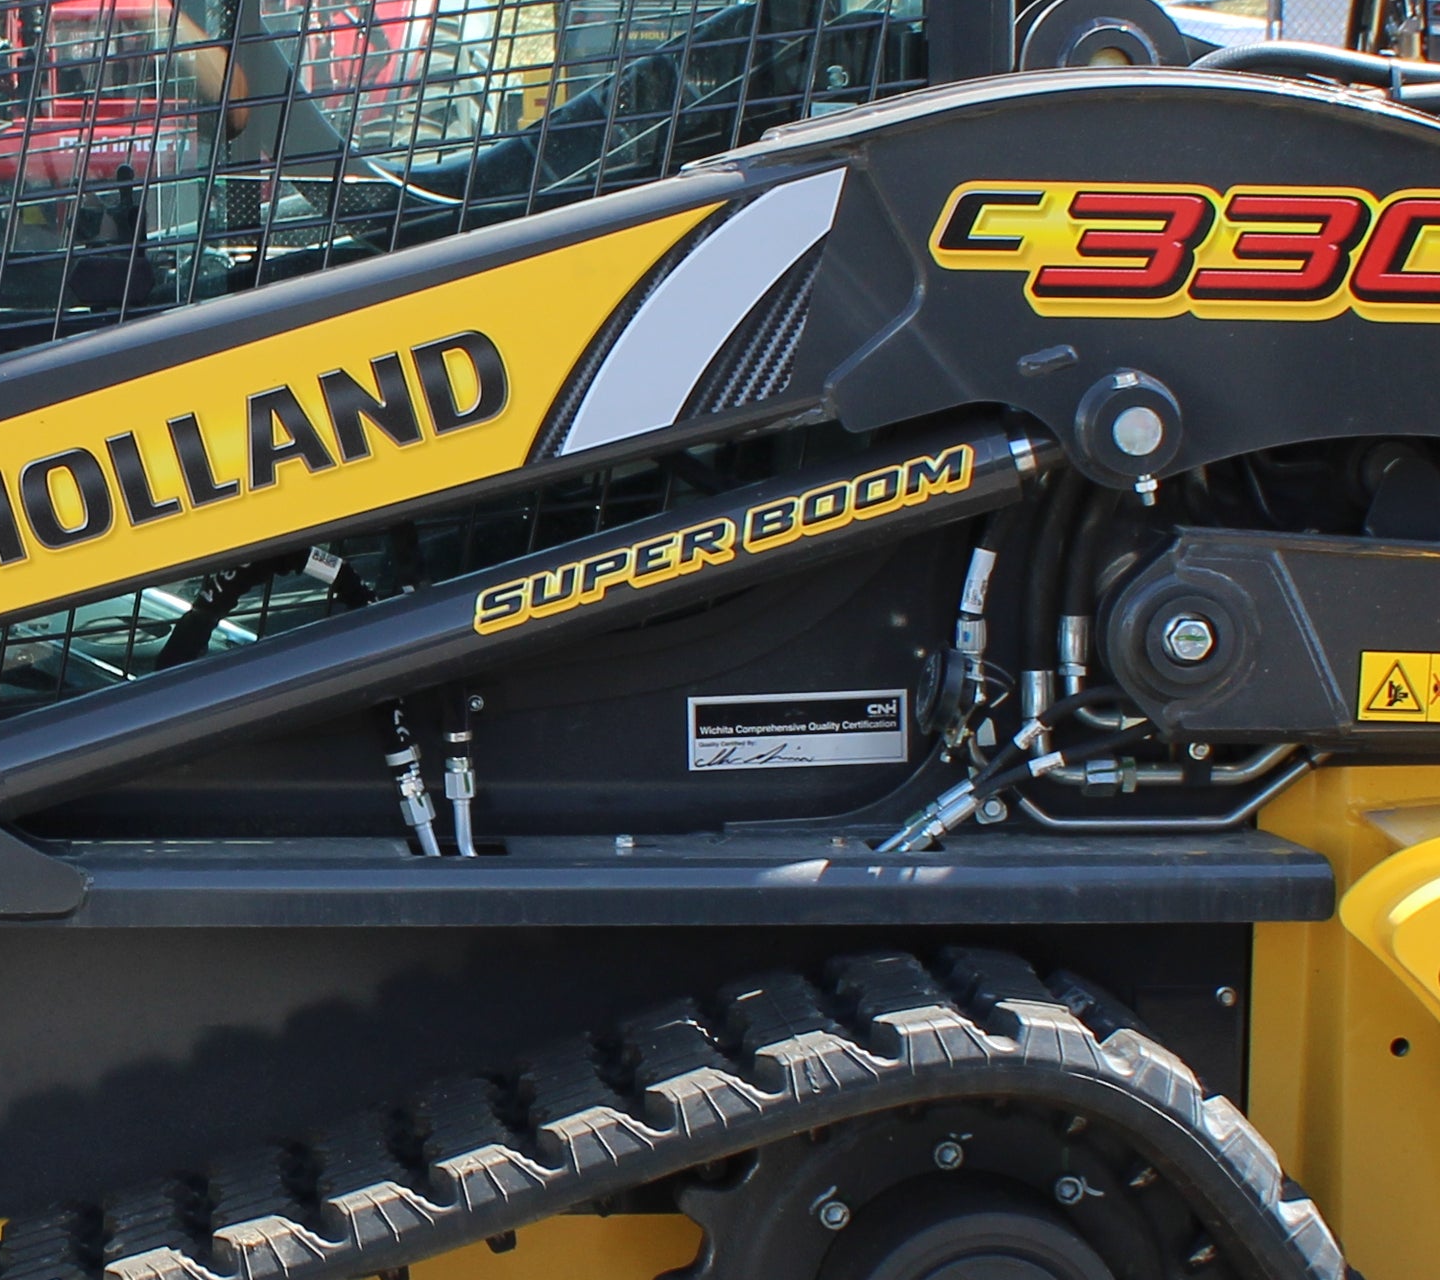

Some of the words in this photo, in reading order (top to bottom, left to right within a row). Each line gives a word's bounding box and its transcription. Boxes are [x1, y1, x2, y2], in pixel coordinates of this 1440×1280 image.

[474, 518, 735, 636] SUPER
[743, 444, 975, 554] BOOM
[699, 725, 734, 736] Wichita
[735, 723, 807, 735] Comprehensive
[808, 721, 840, 732] Quality
[841, 719, 897, 730] Certification
